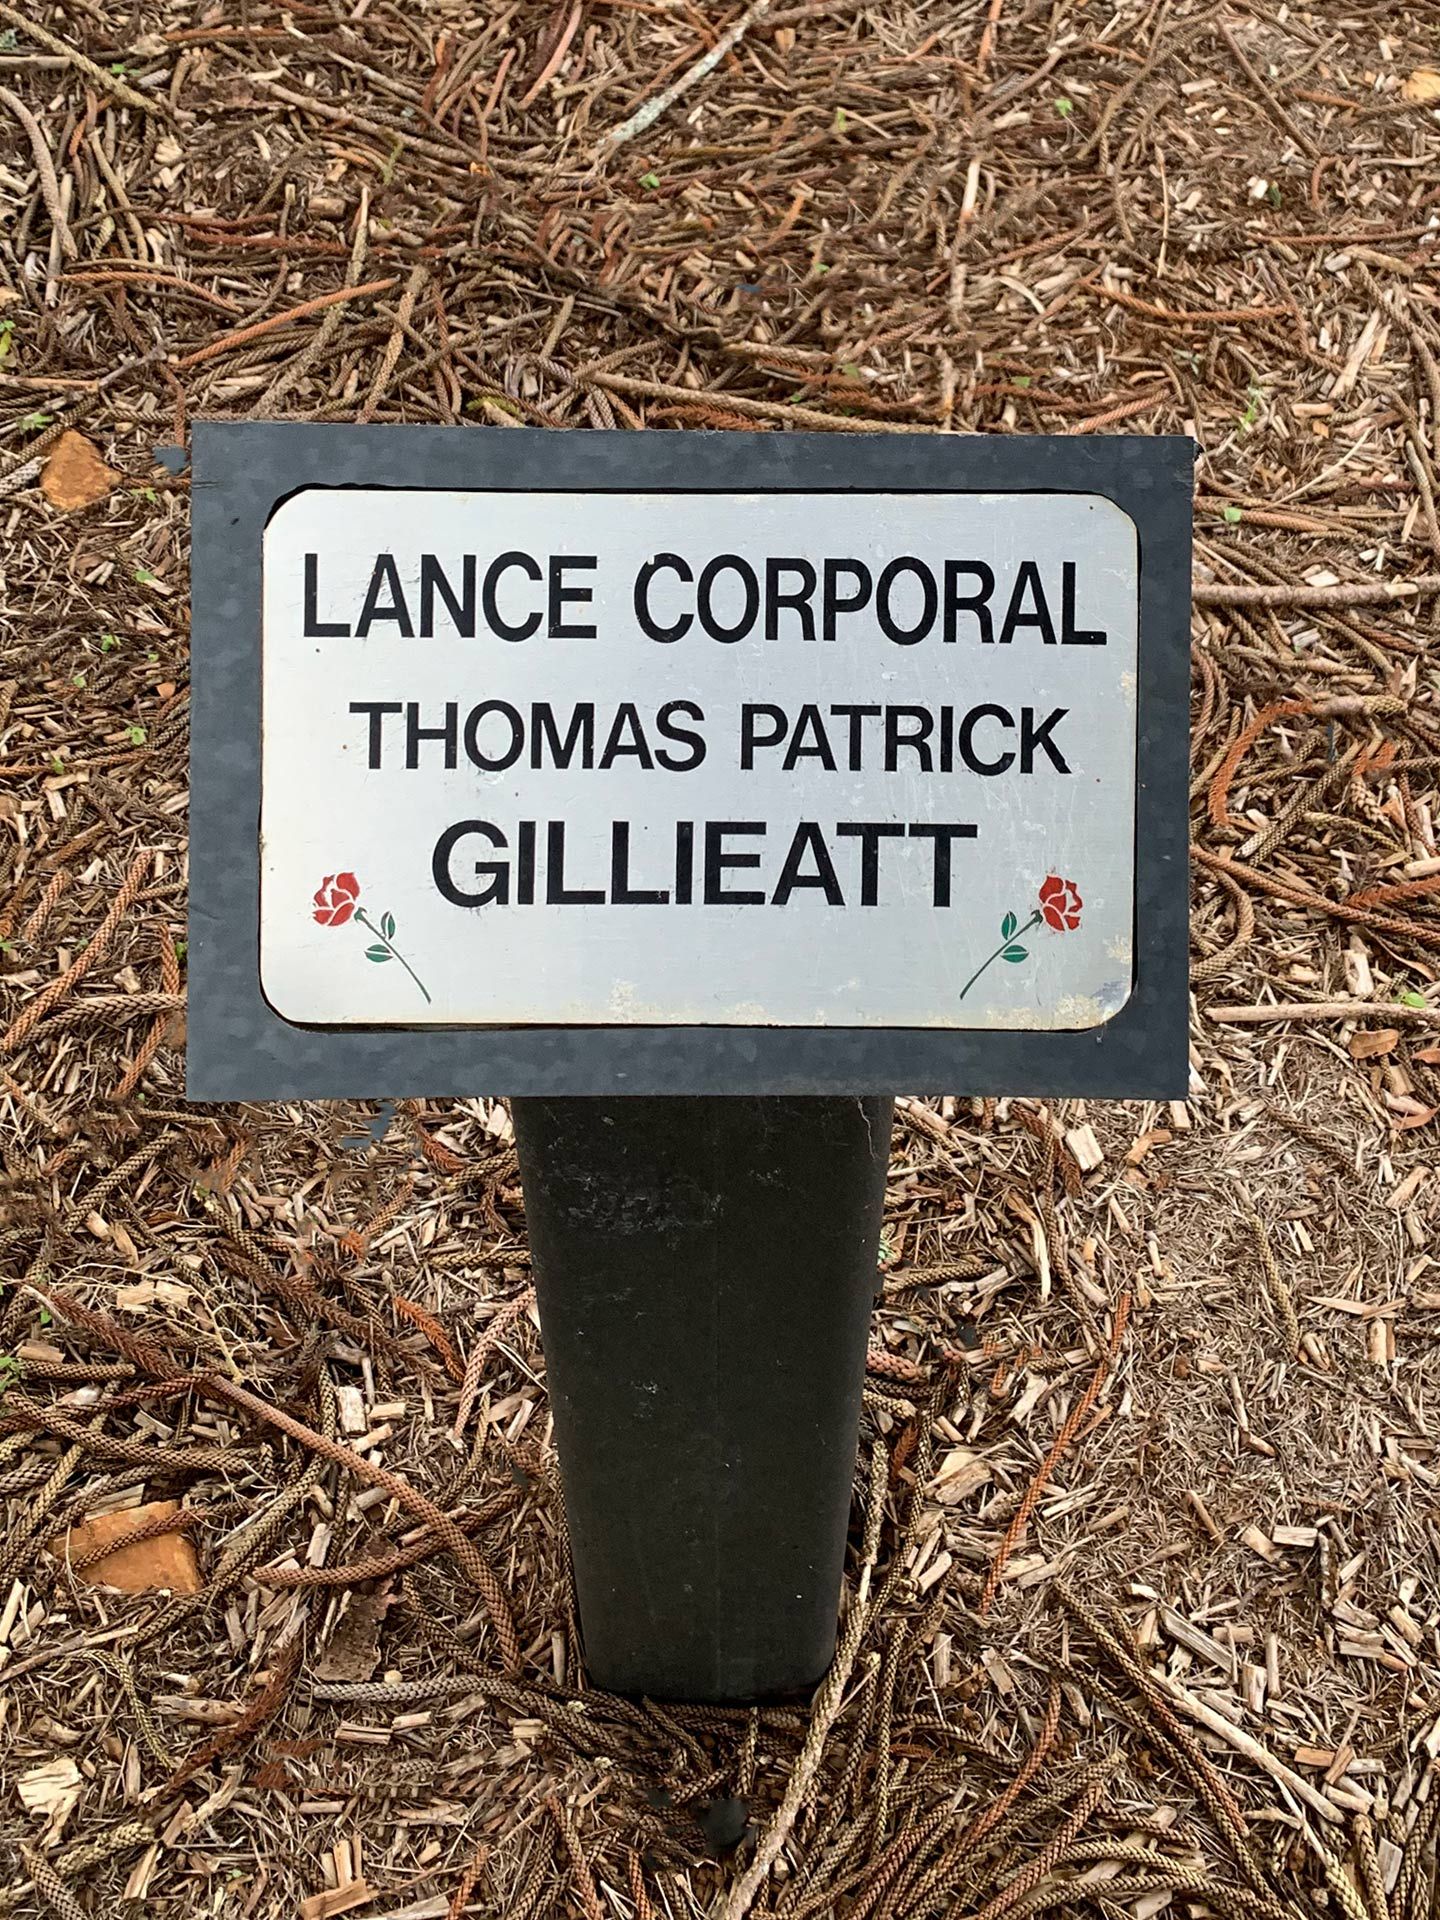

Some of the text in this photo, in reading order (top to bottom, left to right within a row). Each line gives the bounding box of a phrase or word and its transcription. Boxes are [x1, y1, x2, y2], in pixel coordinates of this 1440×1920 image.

[304, 552, 1107, 645] LANCE CORPORAL
[350, 700, 1071, 776] THOMAS PATRICK
[433, 820, 977, 908] GILLIEATT
